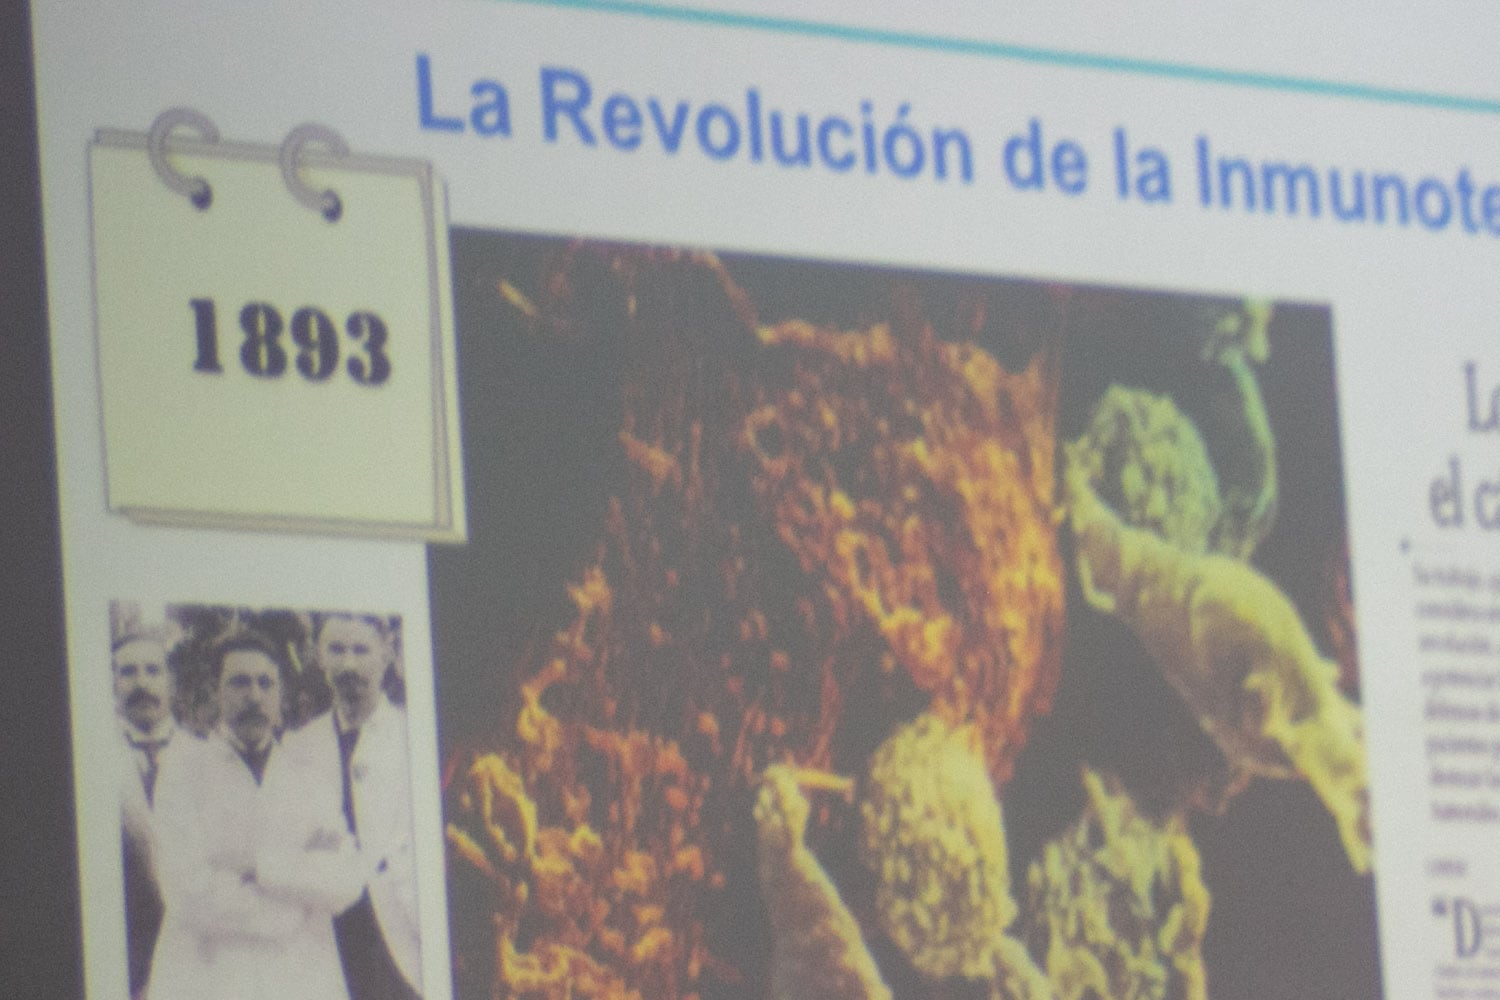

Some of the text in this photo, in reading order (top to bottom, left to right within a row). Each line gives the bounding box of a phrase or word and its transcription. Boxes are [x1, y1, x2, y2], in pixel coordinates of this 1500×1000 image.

[414, 53, 513, 139] La
[540, 65, 974, 184] Revolución
[1002, 117, 1089, 196] de
[1113, 127, 1173, 204] la
[188, 297, 393, 387] 1893
[1428, 455, 1465, 529] el
